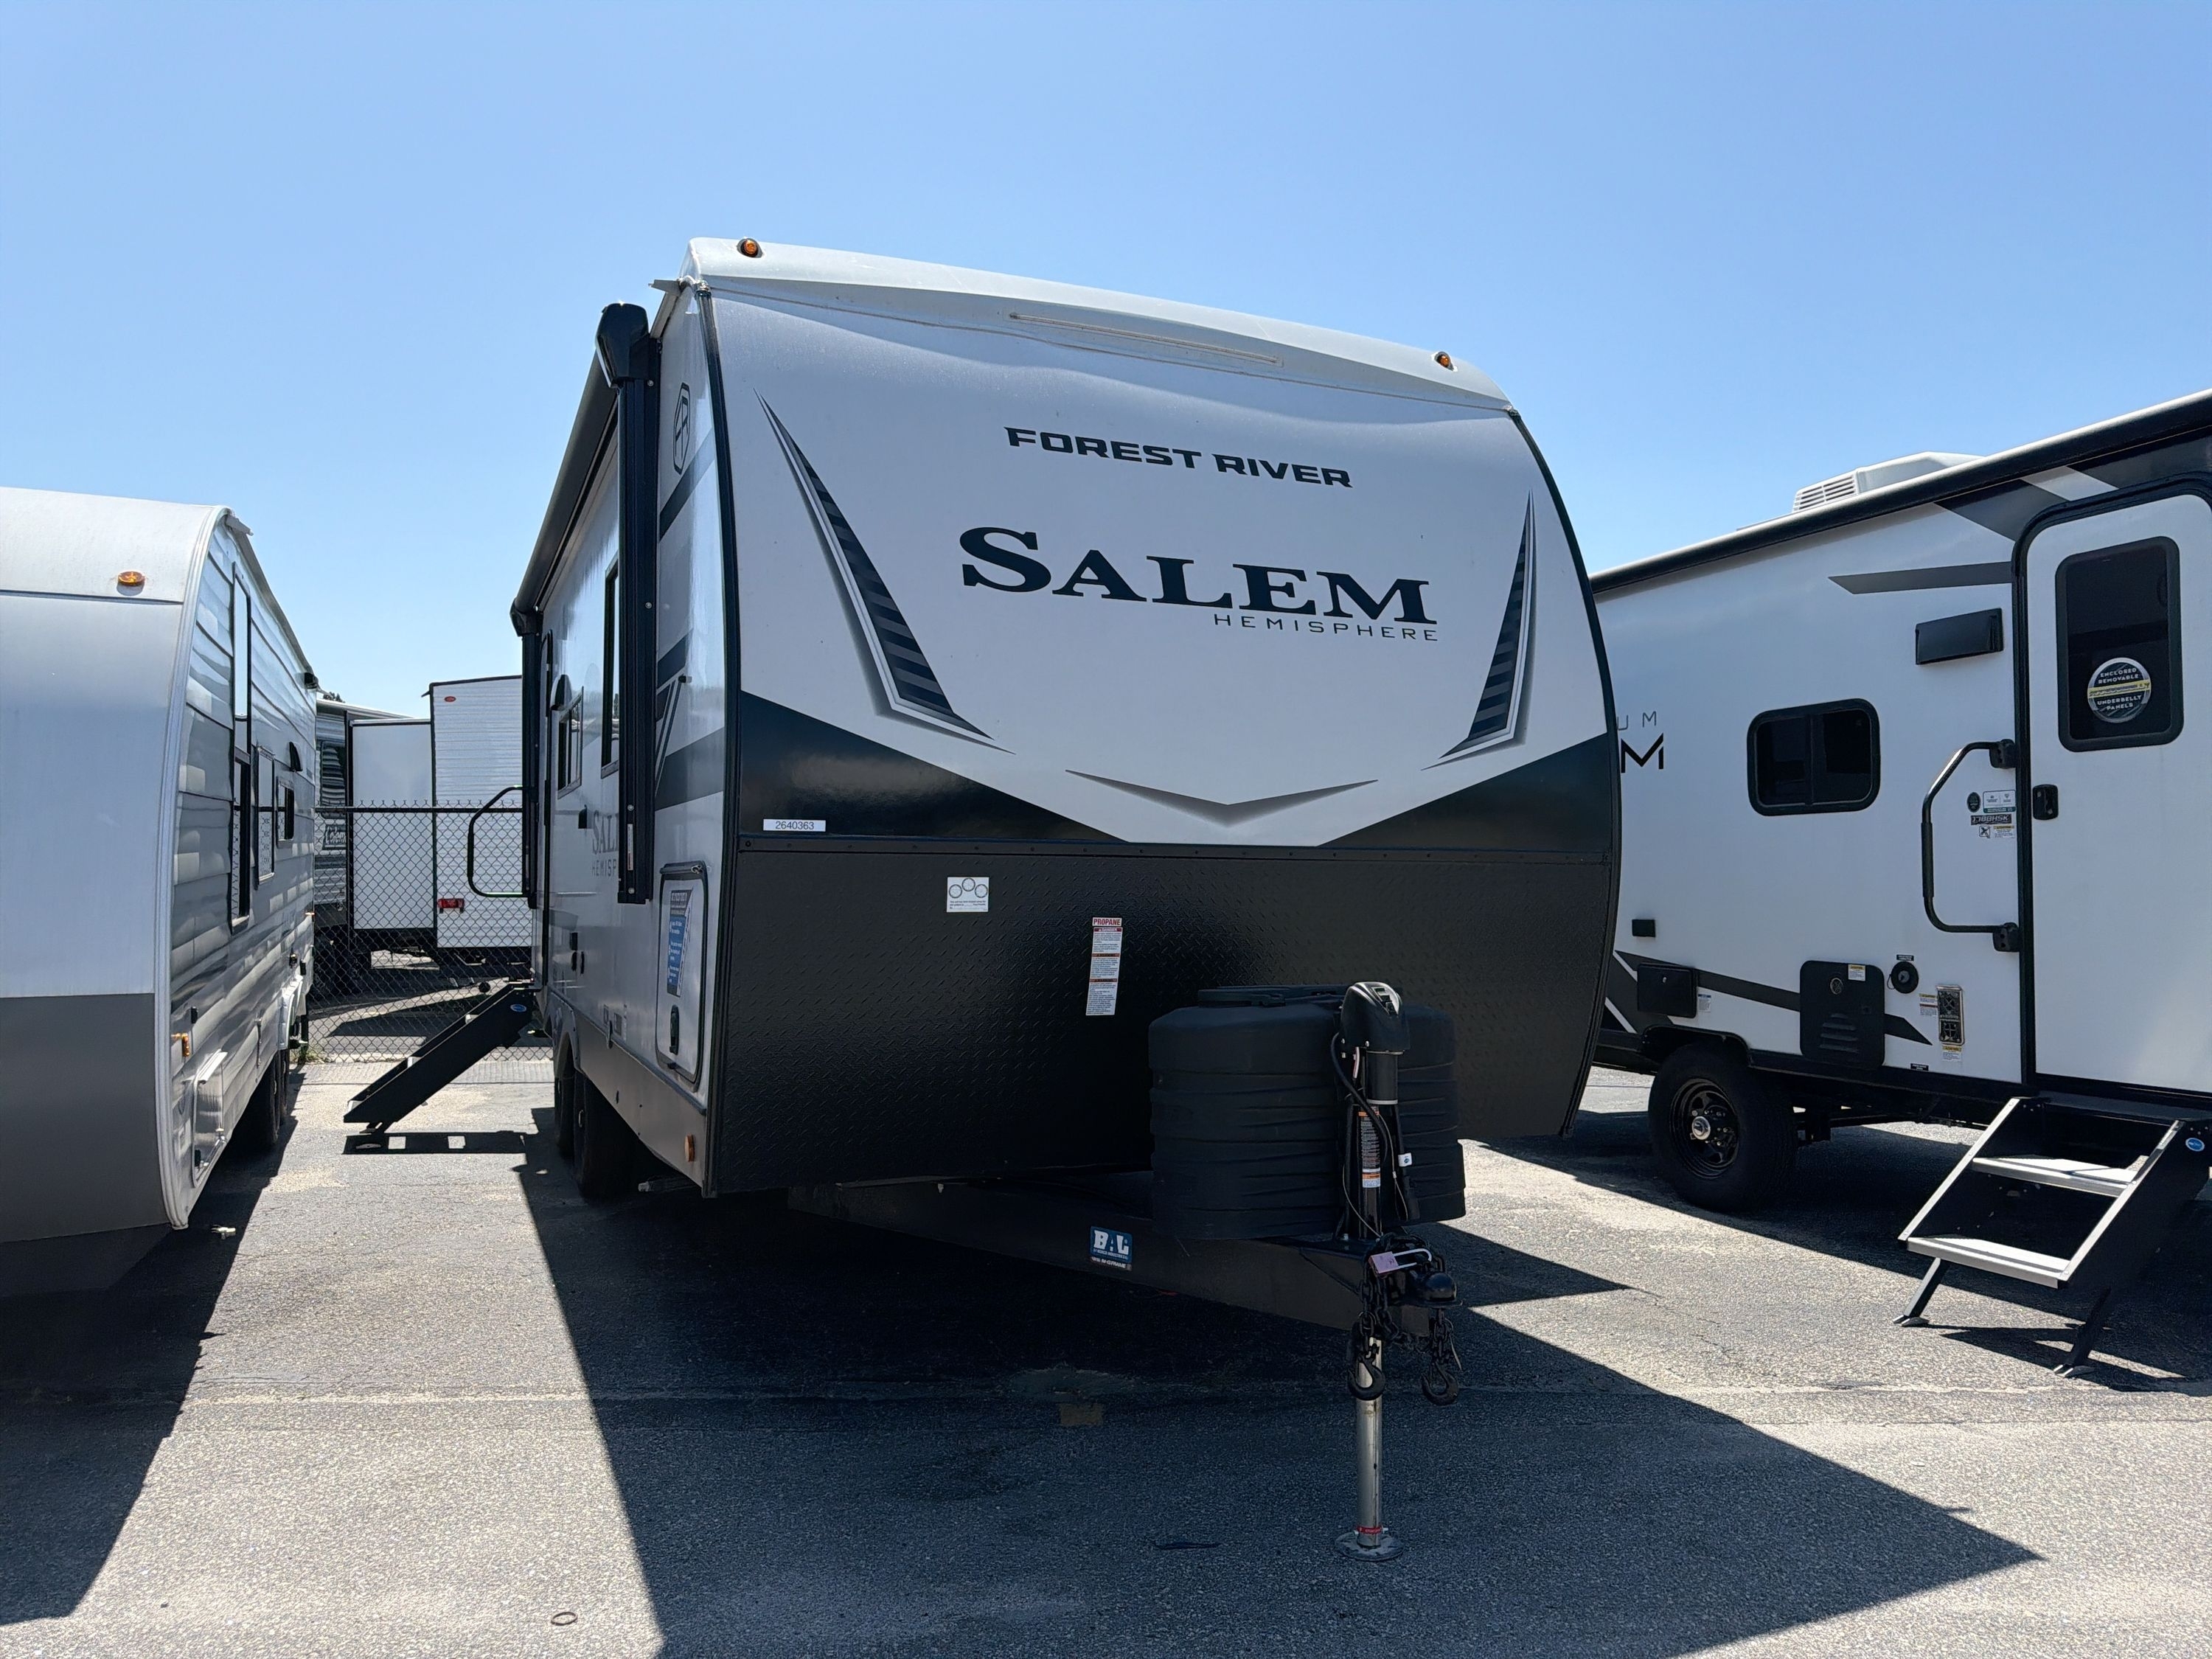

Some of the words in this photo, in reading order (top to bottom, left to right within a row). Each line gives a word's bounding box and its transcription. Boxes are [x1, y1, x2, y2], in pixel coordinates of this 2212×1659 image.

[1004, 426, 1202, 469] FOREST
[1211, 453, 1353, 488] RIVER
[959, 526, 1438, 625] SALEM
[1214, 613, 1439, 641] HEMISPHERE
[2100, 667, 2137, 678] ENCLOSED
[2098, 673, 2139, 684] REMOVABLE
[2097, 695, 2142, 705] UNDERBELLY
[2107, 702, 2134, 711] PANELS
[775, 821, 815, 830] 2640363
[1093, 918, 1121, 926] PROPANE
